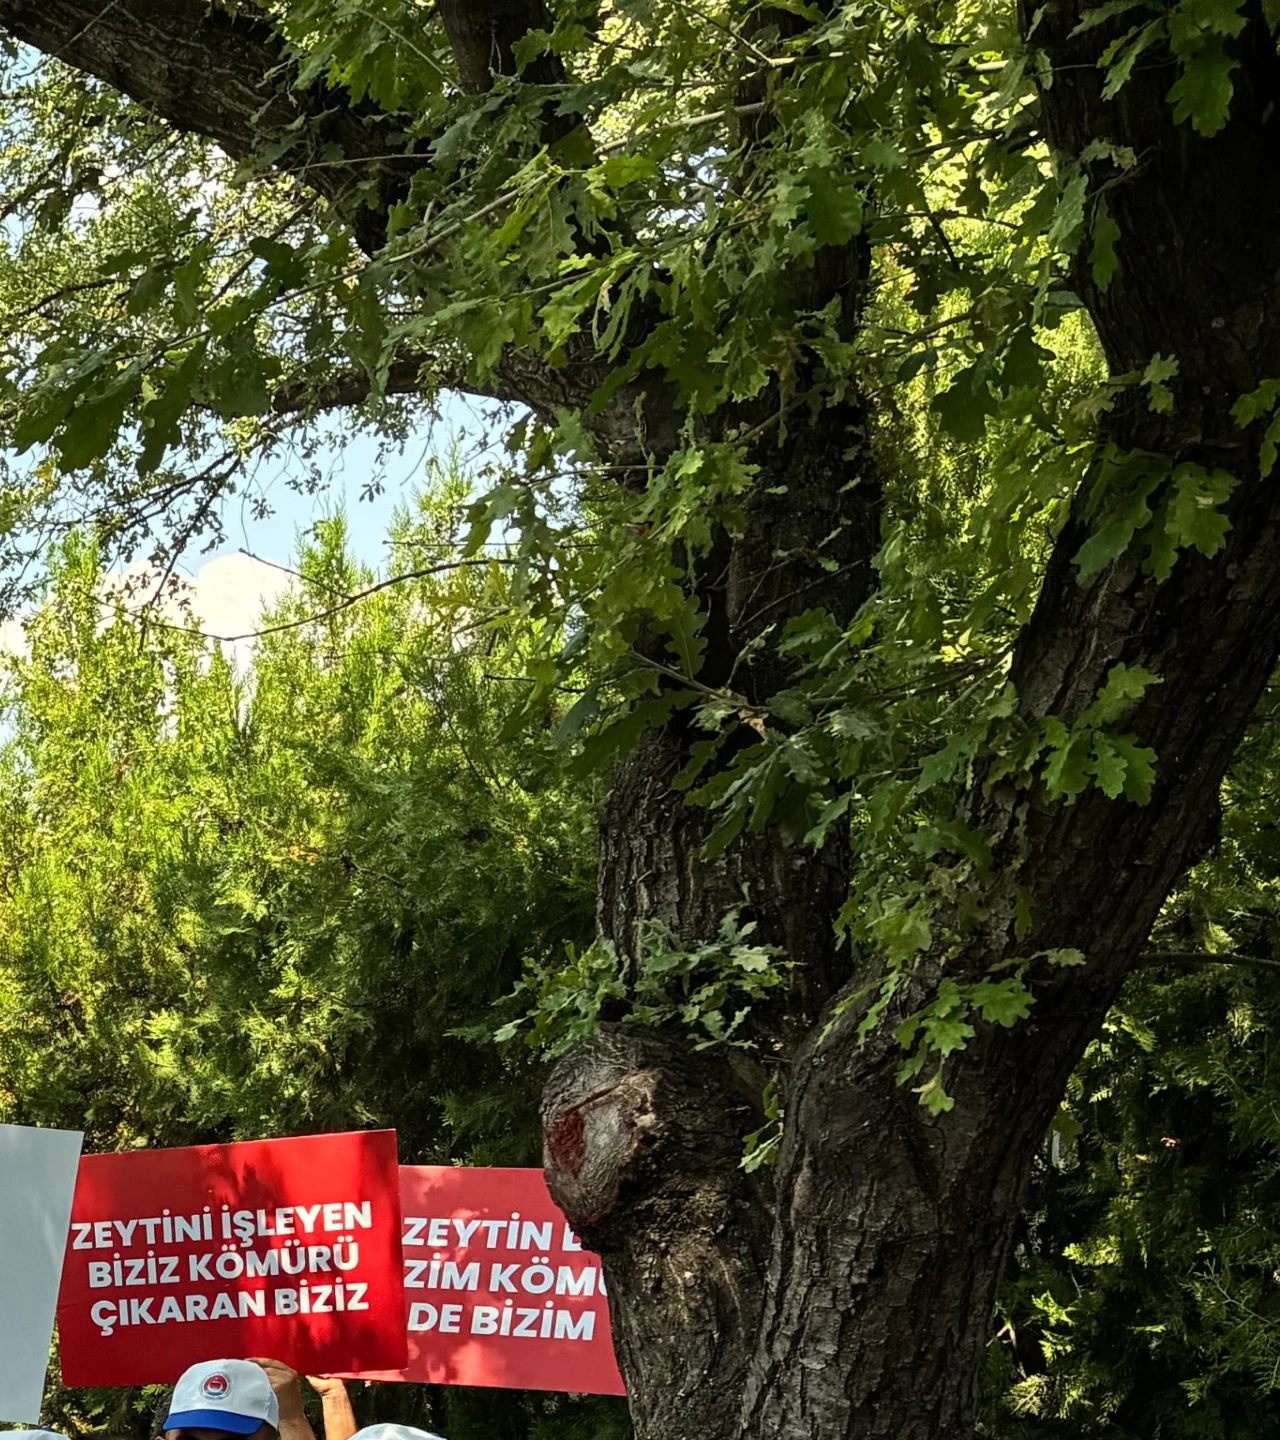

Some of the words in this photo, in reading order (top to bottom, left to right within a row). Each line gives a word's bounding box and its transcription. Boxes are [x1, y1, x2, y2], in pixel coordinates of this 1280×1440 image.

[71, 1205, 213, 1251] ZEYTİNİ
[221, 1200, 373, 1247] İŞLEYEN
[402, 1212, 553, 1252] ZEYTİN
[87, 1251, 181, 1289] BİZİZ
[189, 1235, 359, 1282] KÖMÜRÜ
[90, 1288, 267, 1337] ÇIKARAN
[275, 1278, 370, 1317] BİZİZ
[407, 1302, 463, 1334] DE
[470, 1298, 596, 1341] BİZİM
